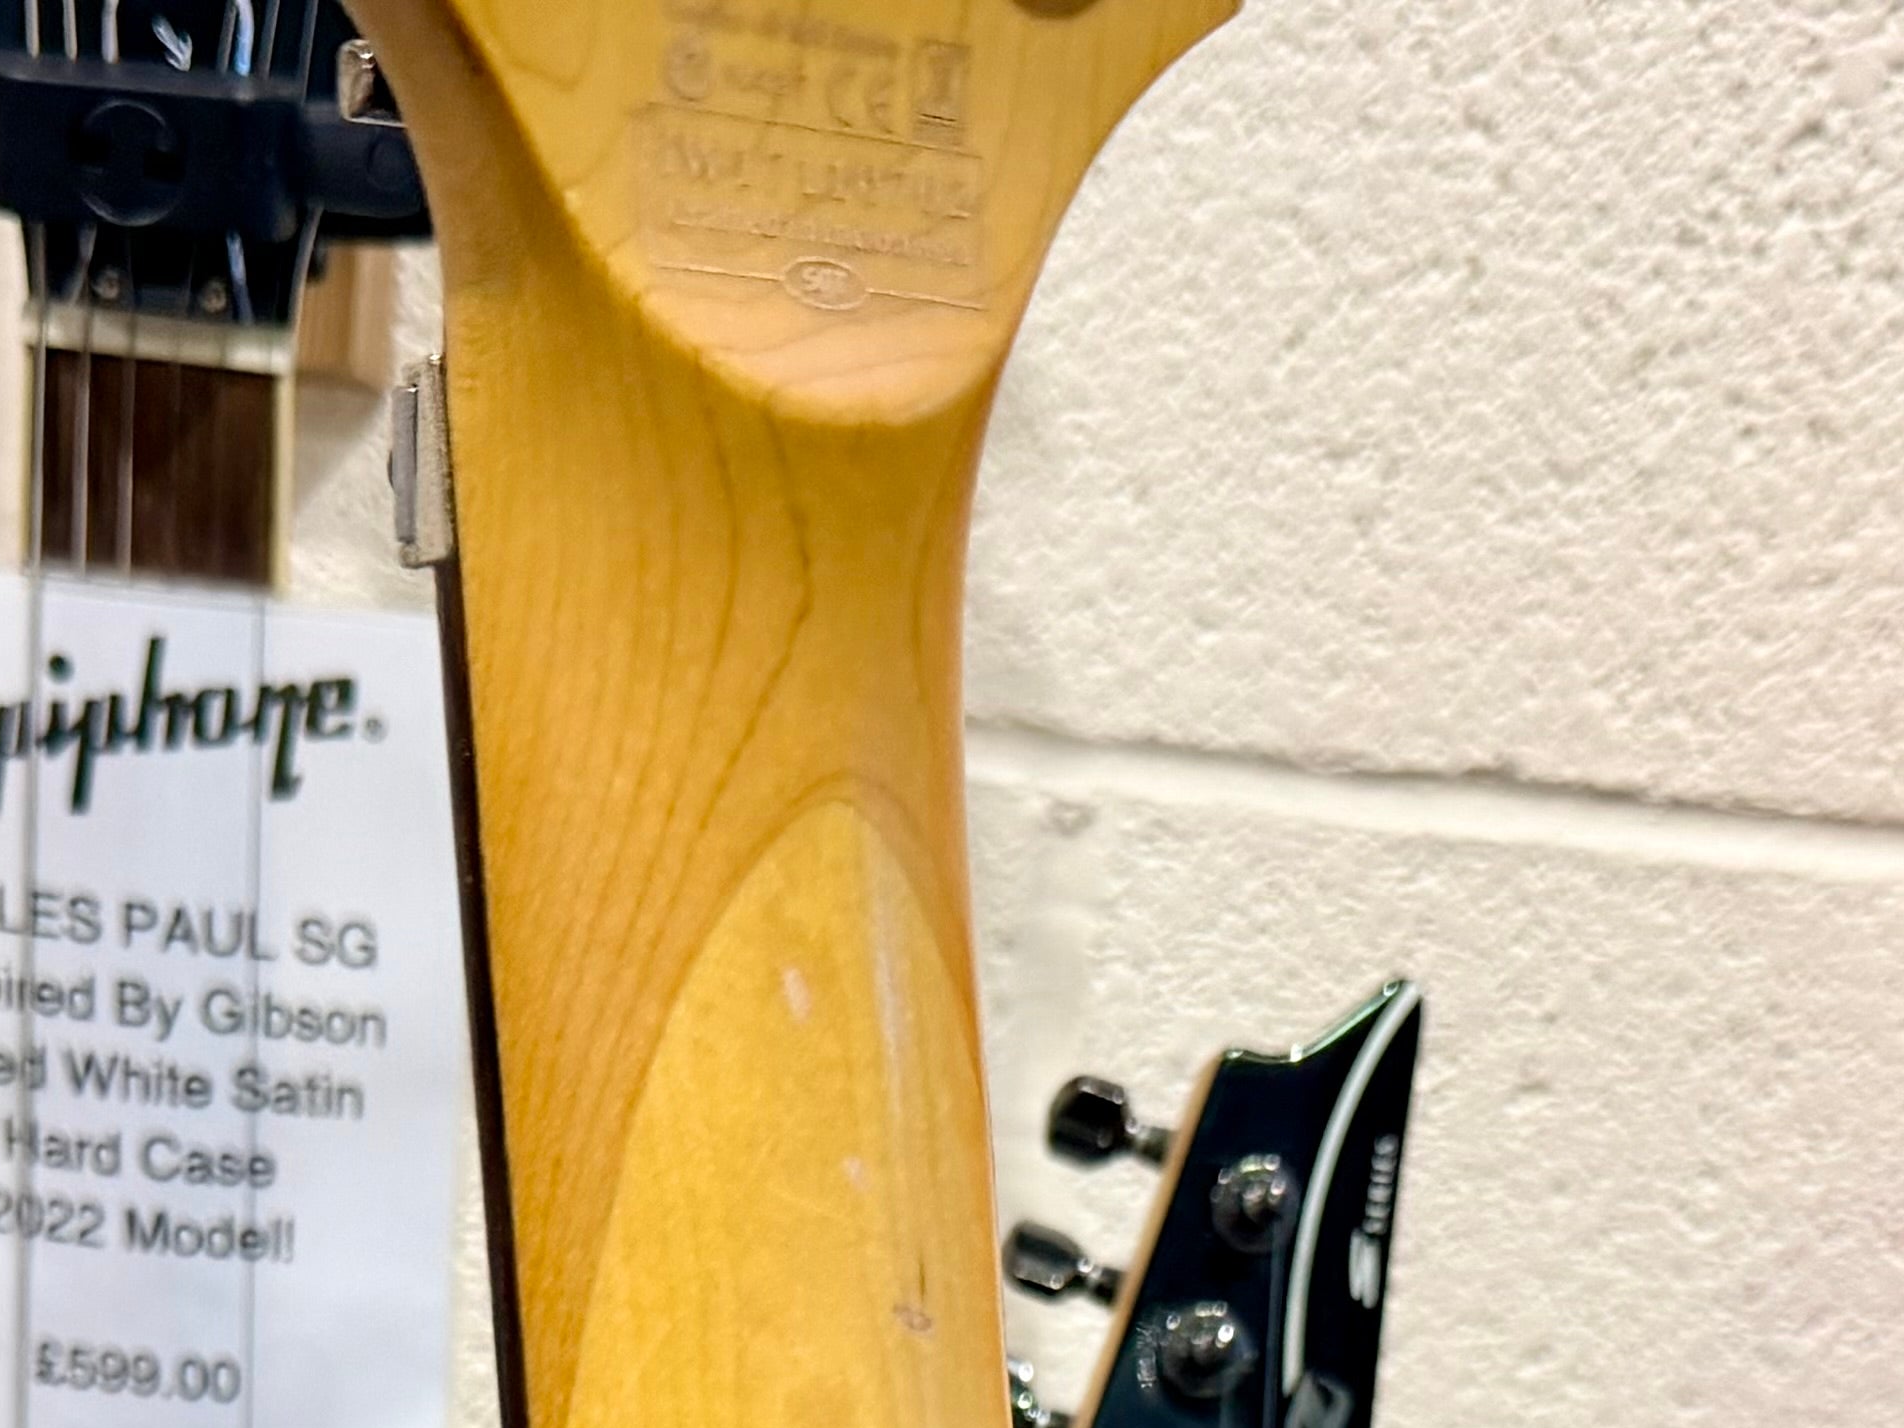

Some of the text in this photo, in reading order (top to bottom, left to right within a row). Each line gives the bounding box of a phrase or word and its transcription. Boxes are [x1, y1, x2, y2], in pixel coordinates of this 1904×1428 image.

[120, 901, 278, 961] PAUL
[296, 917, 378, 968] SG
[116, 977, 181, 1046] By
[199, 986, 386, 1046] Gibson
[65, 1048, 214, 1109] White
[231, 1066, 366, 1120] Satin
[4, 1118, 277, 1190] Hard Case
[35, 1339, 242, 1405] £599.00
